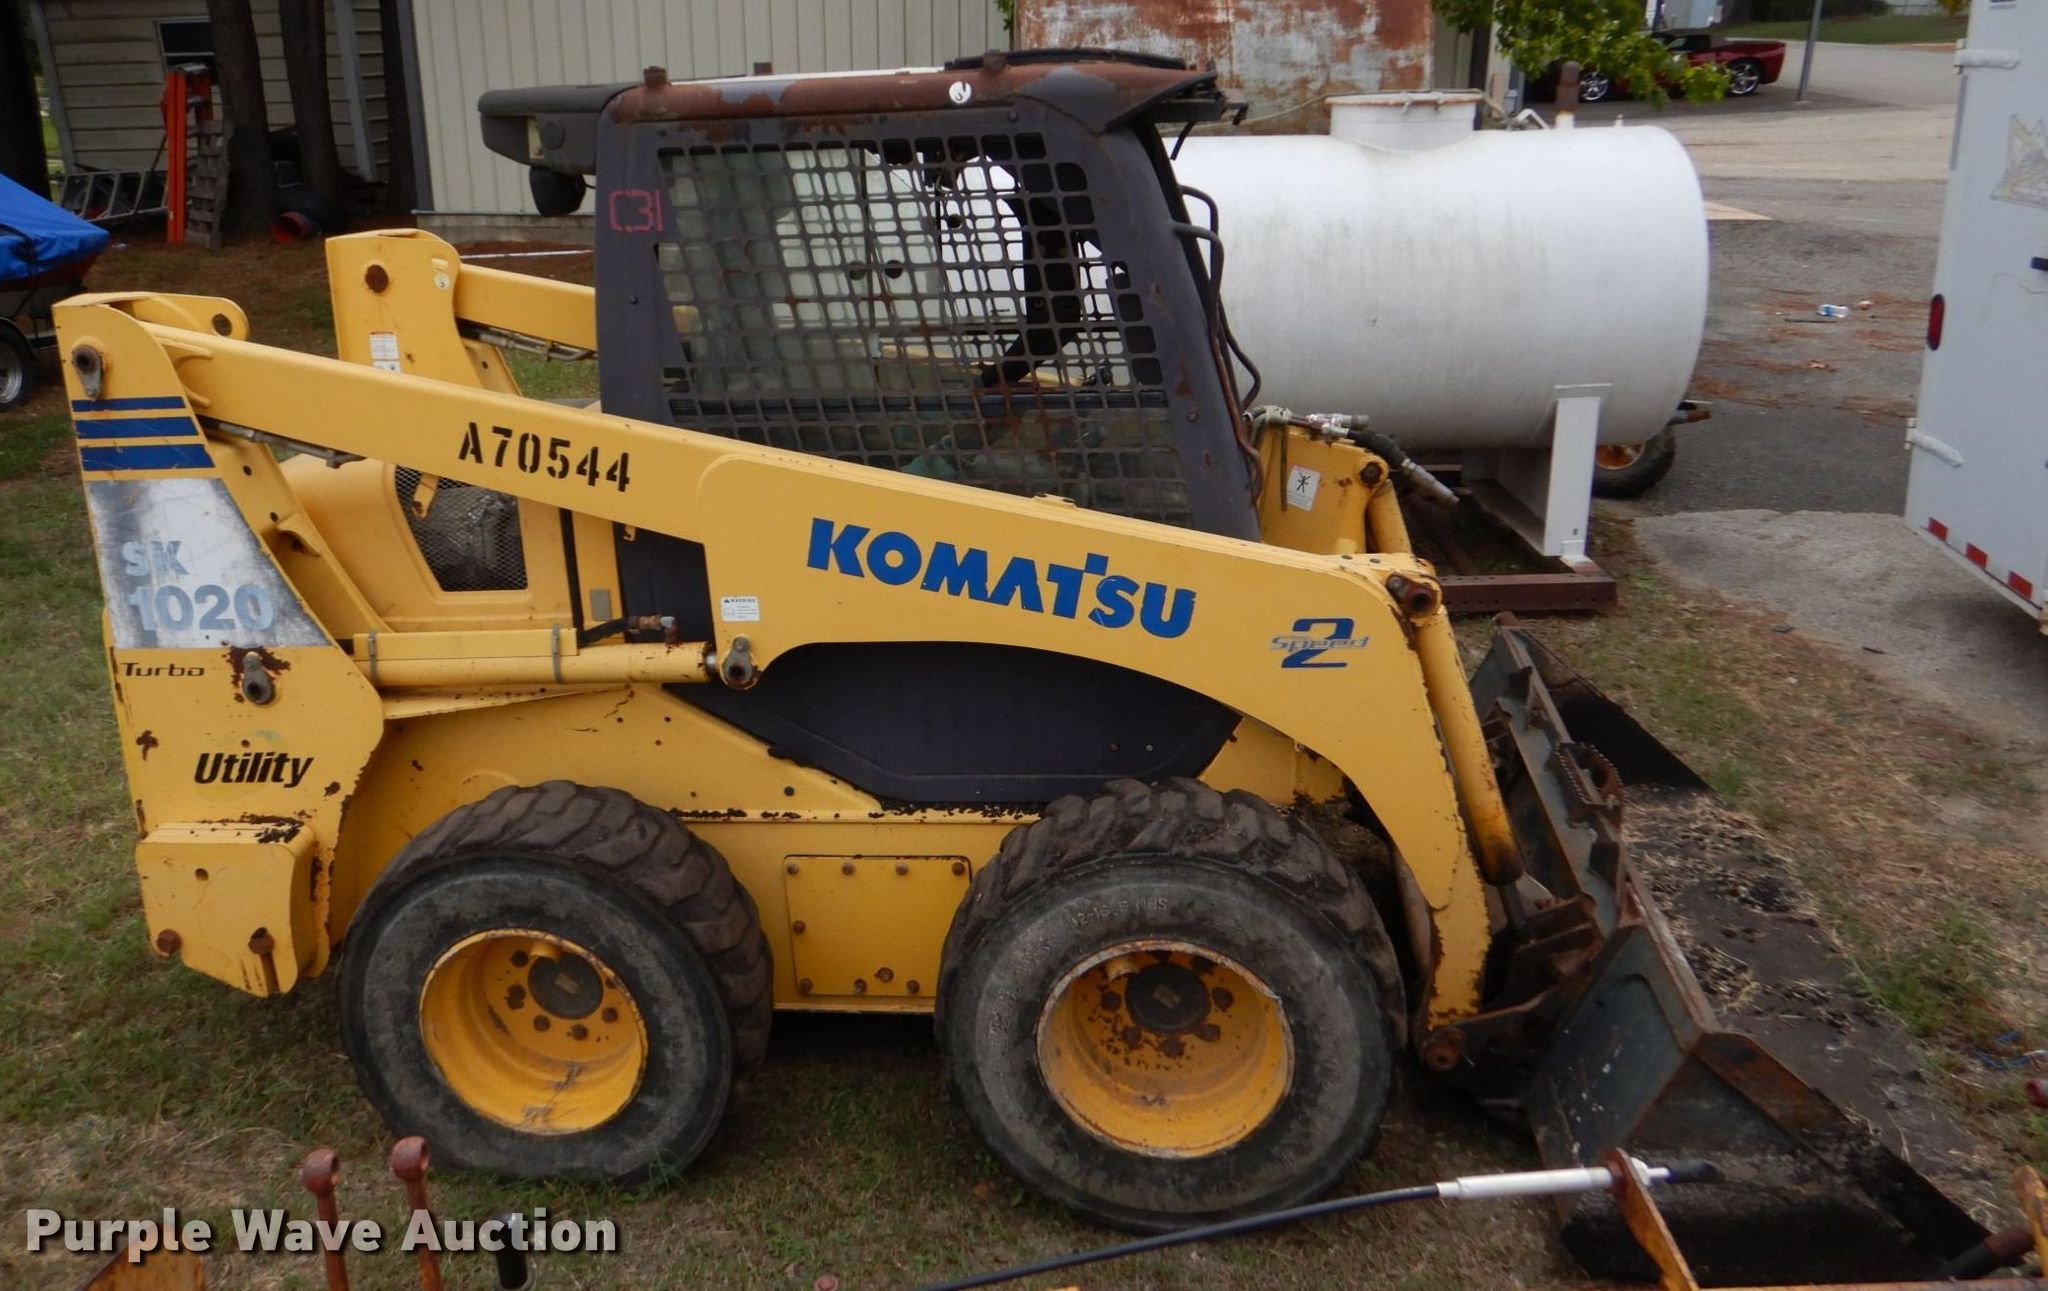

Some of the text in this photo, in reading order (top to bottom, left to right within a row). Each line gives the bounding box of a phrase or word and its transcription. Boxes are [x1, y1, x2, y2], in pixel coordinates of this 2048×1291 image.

[458, 422, 630, 493] A70544
[122, 540, 190, 577] SK
[807, 517, 1197, 639] KOMATSU
[128, 583, 275, 632] 1020
[1281, 618, 1355, 668] 2
[121, 662, 205, 677] Turbo
[194, 752, 315, 788] Utility
